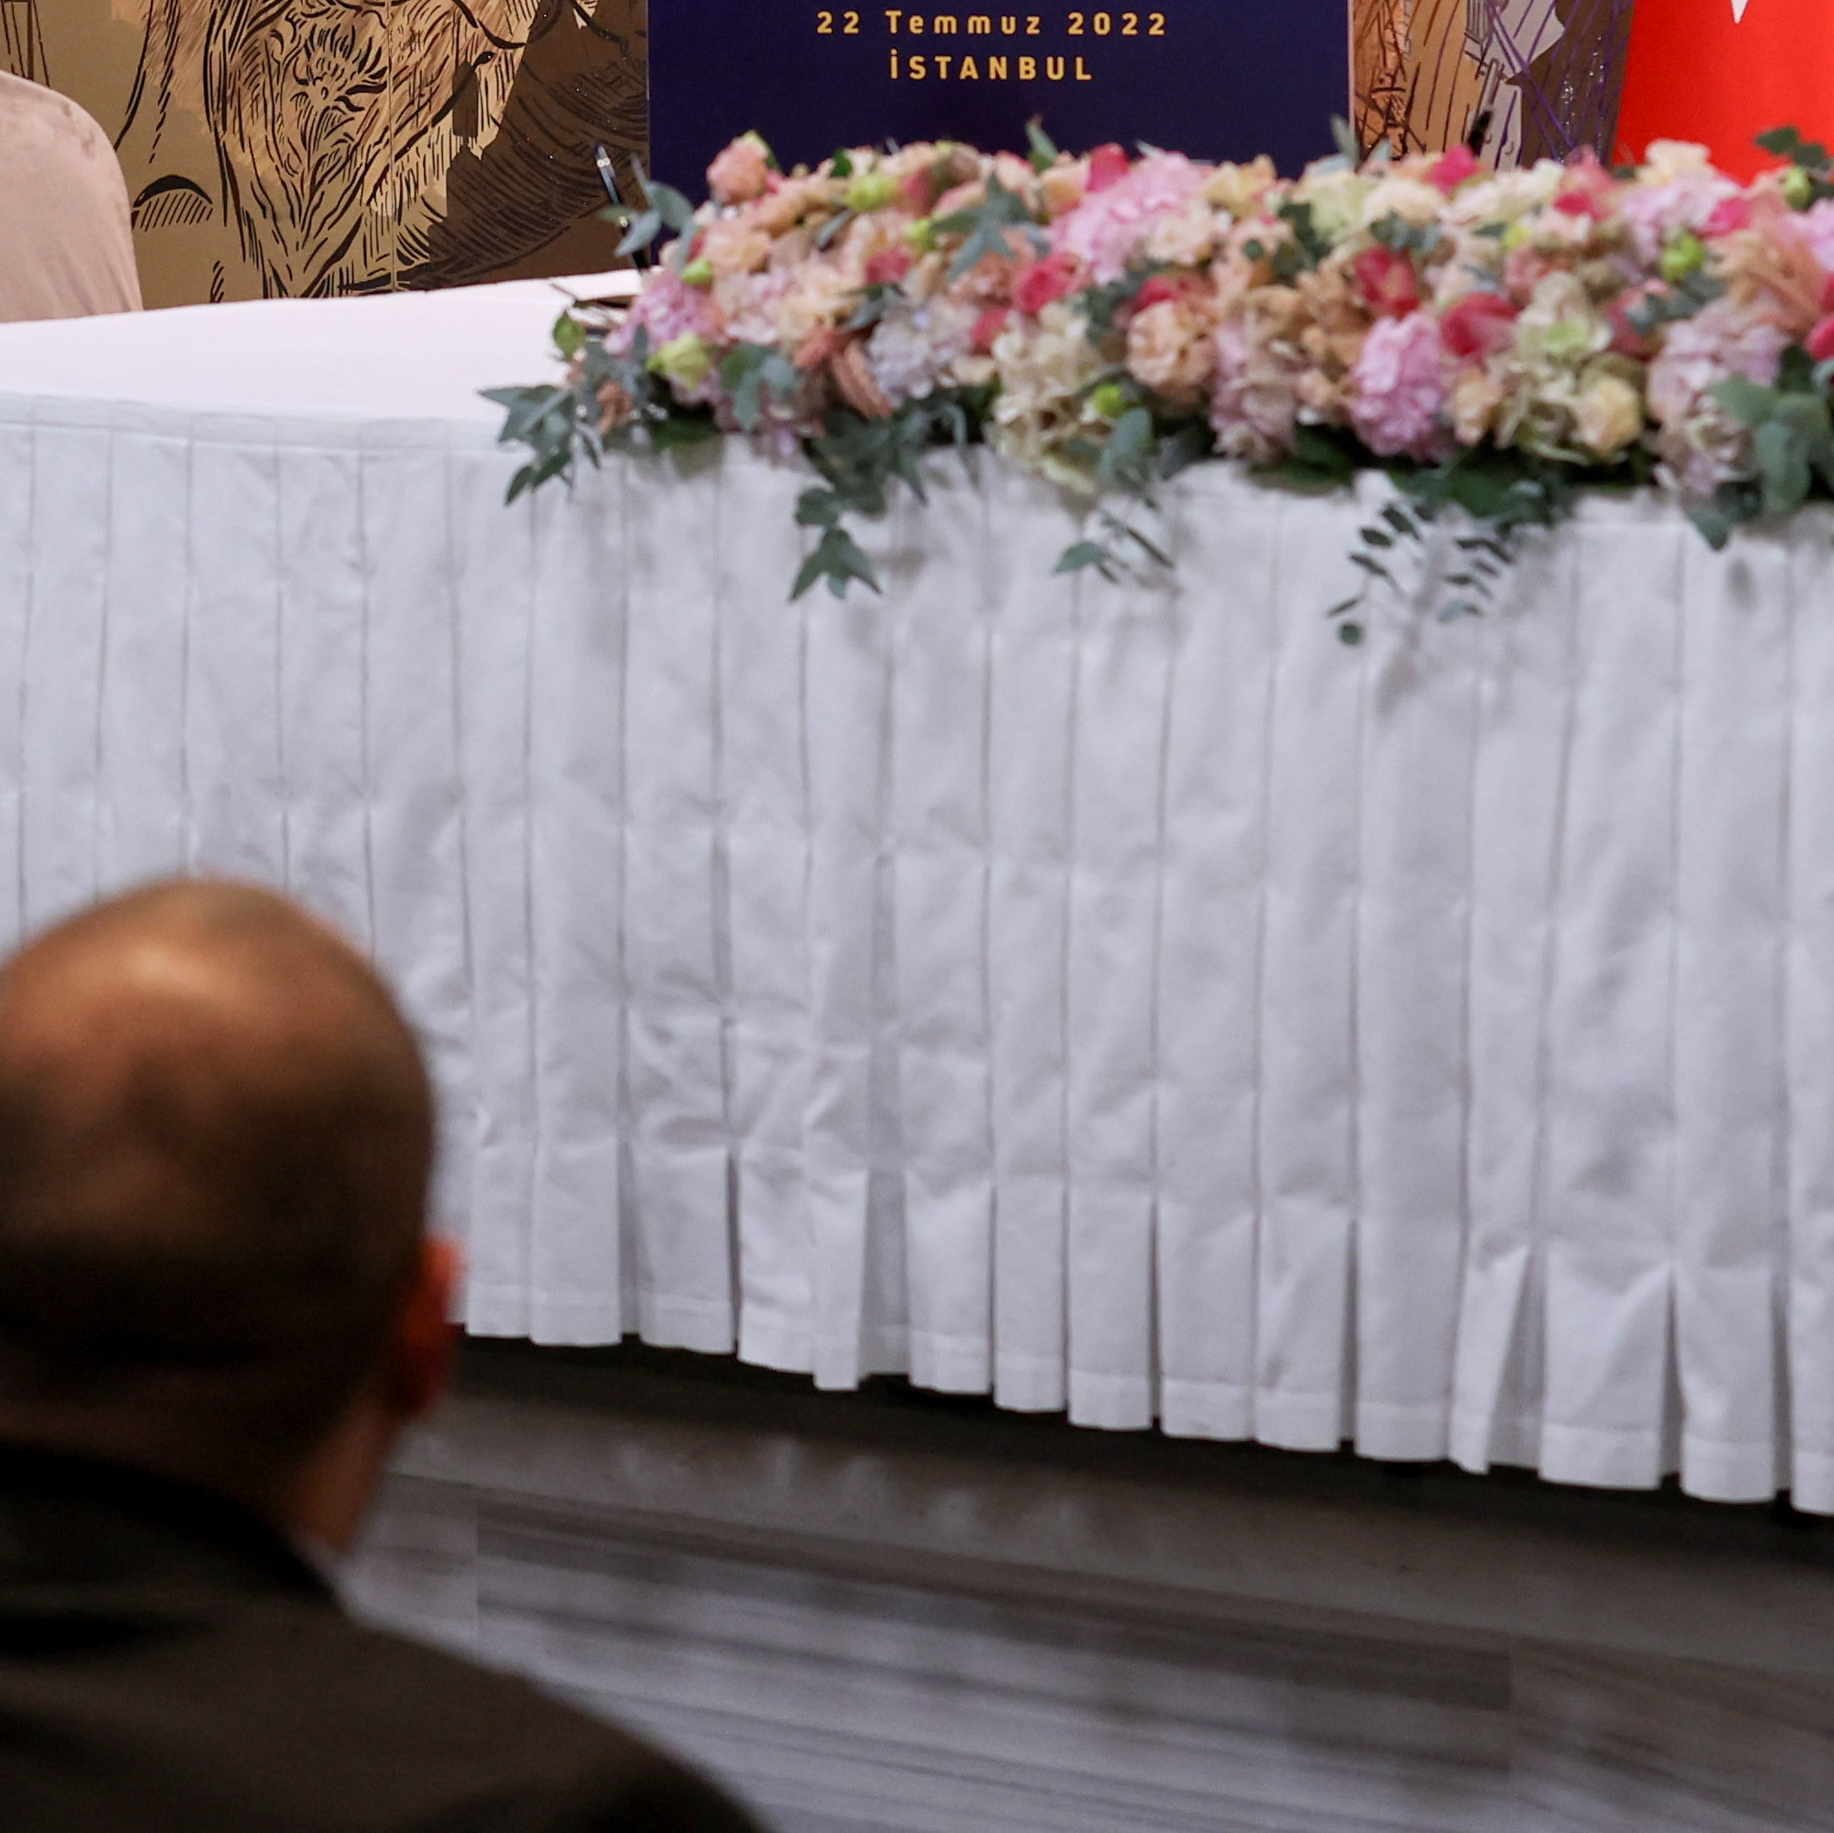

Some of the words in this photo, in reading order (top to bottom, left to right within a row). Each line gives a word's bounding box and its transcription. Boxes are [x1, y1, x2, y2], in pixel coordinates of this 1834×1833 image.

[816, 10, 860, 35] 22
[884, 9, 1042, 36] Temmuz
[1067, 10, 1166, 37] 2022
[889, 47, 1093, 82] İSTANBUL
